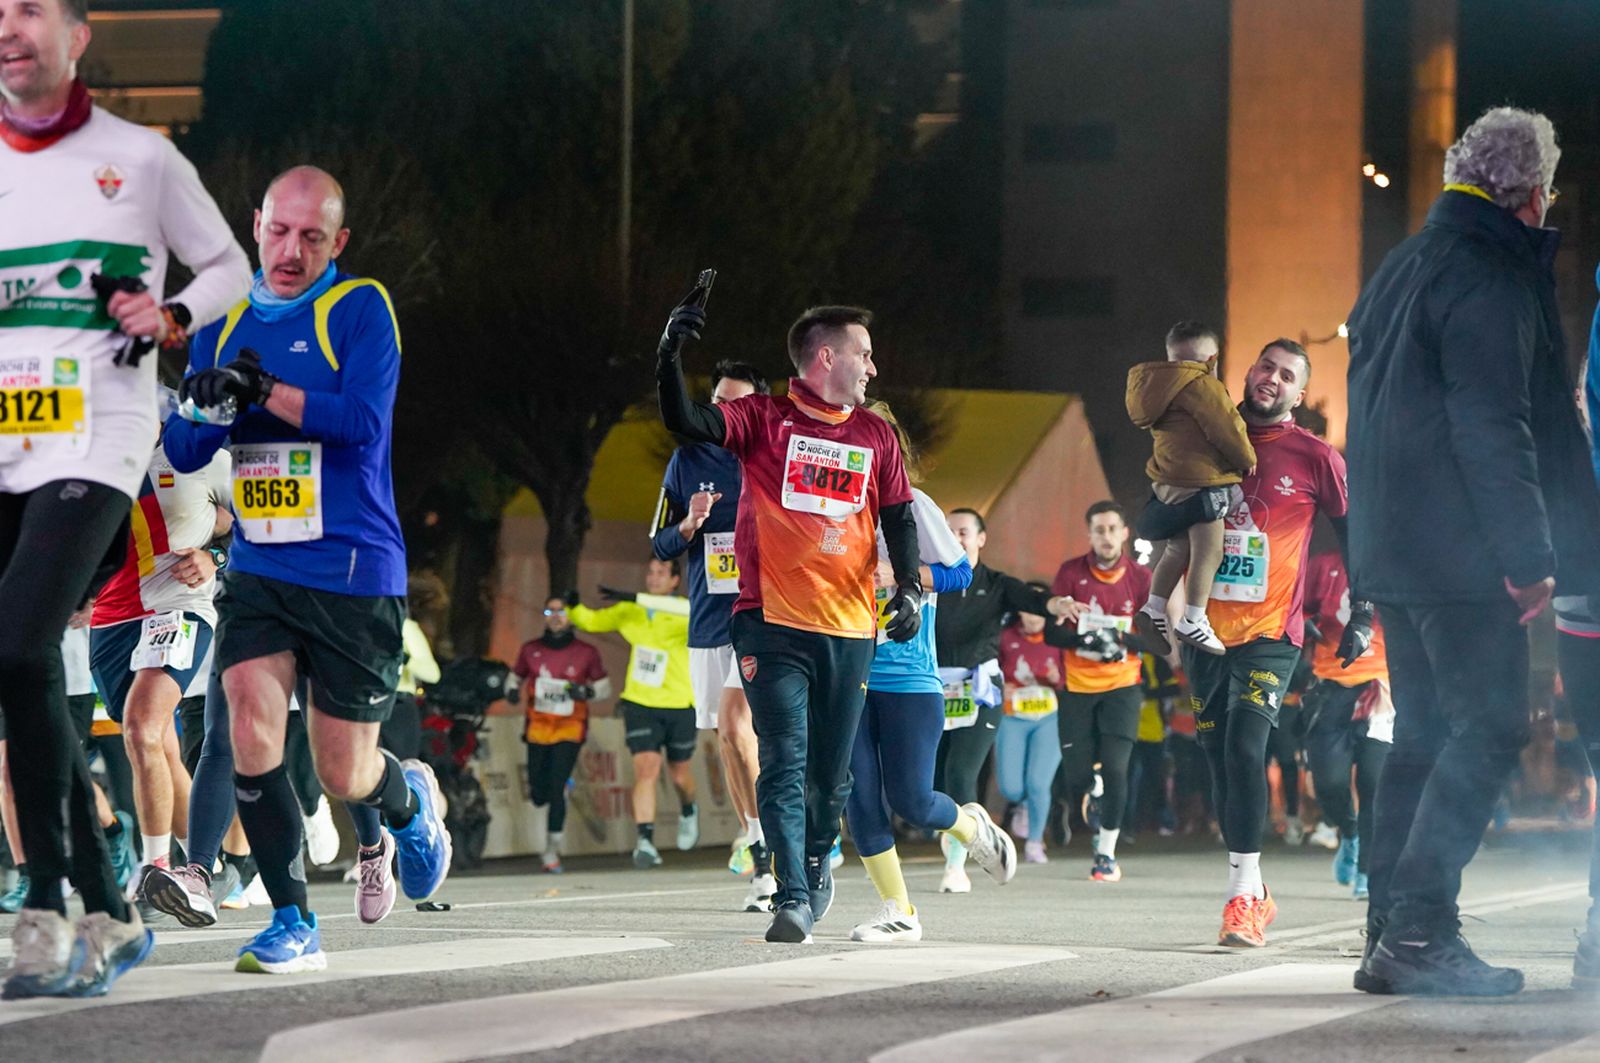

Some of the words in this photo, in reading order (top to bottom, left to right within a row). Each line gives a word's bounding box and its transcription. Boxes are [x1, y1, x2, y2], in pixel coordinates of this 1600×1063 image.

[795, 453, 813, 463] SAN
[807, 446, 830, 457] NOCHE
[831, 450, 842, 460] DE
[269, 454, 280, 464] DE
[239, 467, 251, 477] SAN
[801, 463, 853, 494] 9812
[243, 478, 300, 508] 8563
[823, 536, 840, 544] SAN
